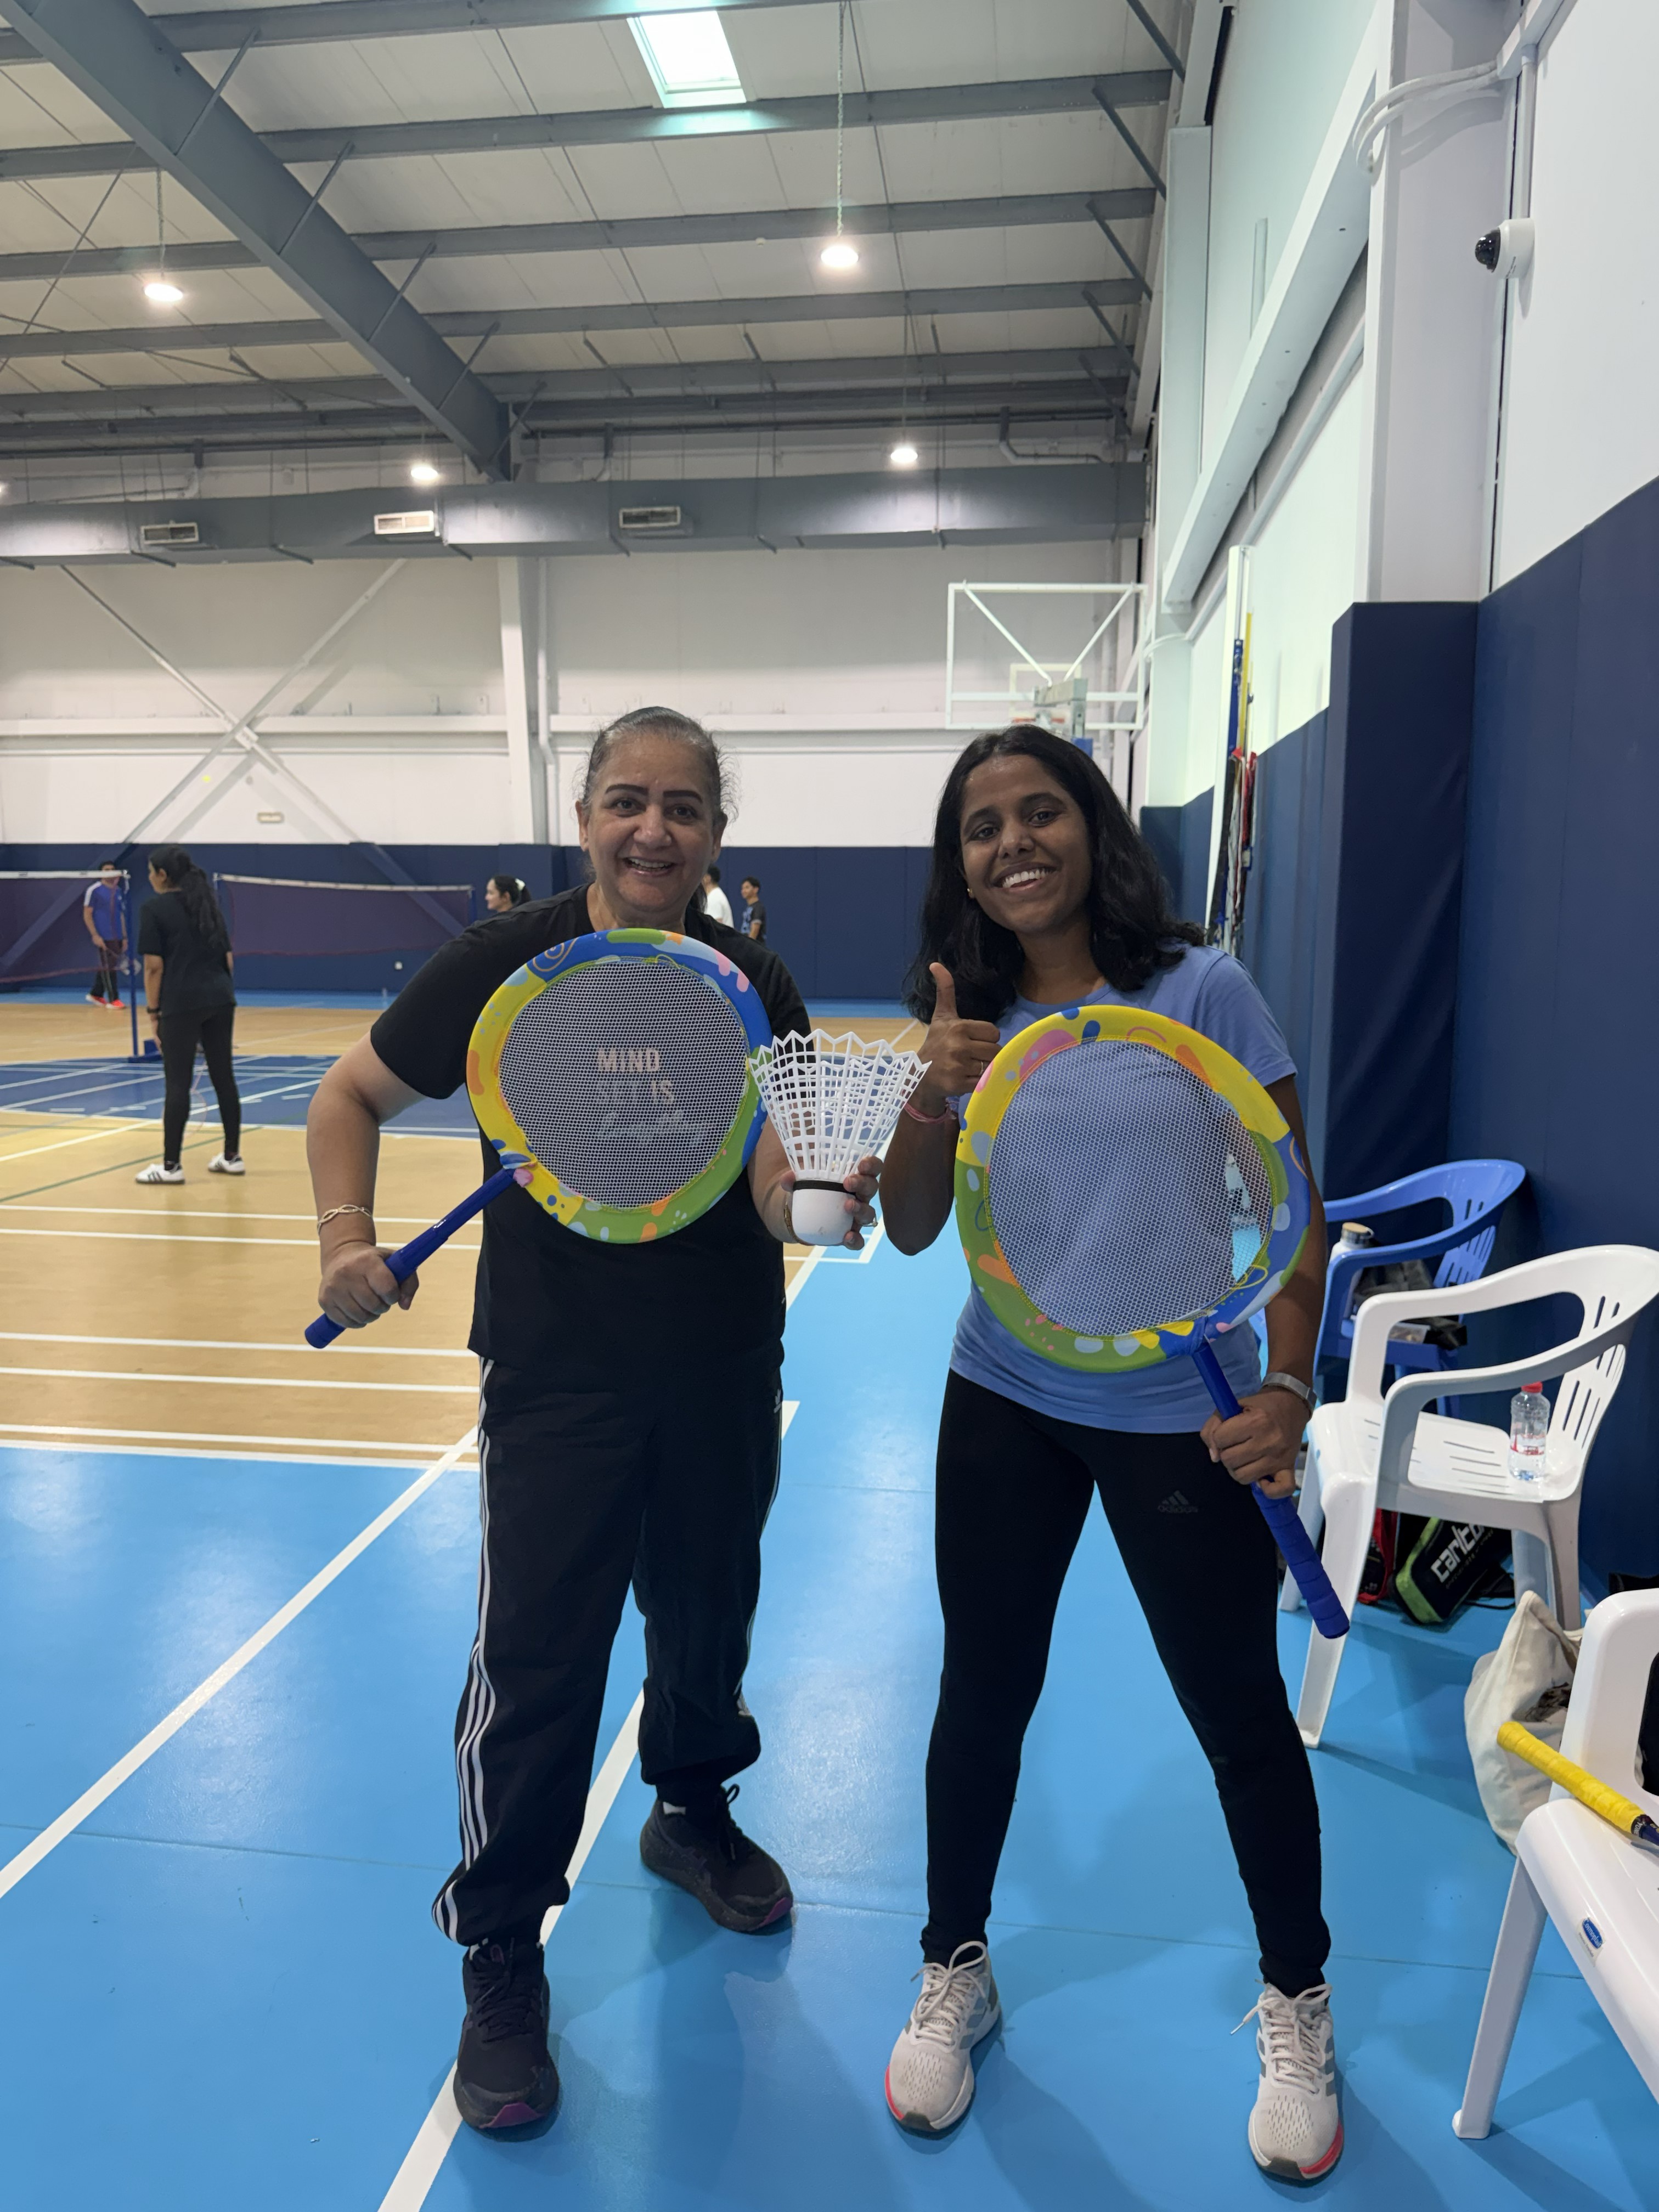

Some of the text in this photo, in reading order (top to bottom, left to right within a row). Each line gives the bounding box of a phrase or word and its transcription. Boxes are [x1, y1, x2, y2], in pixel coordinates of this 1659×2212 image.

[596, 1047, 661, 1073] MIND
[651, 1079, 676, 1105] IS
[1583, 1918, 1602, 1948] Cosmoplast
